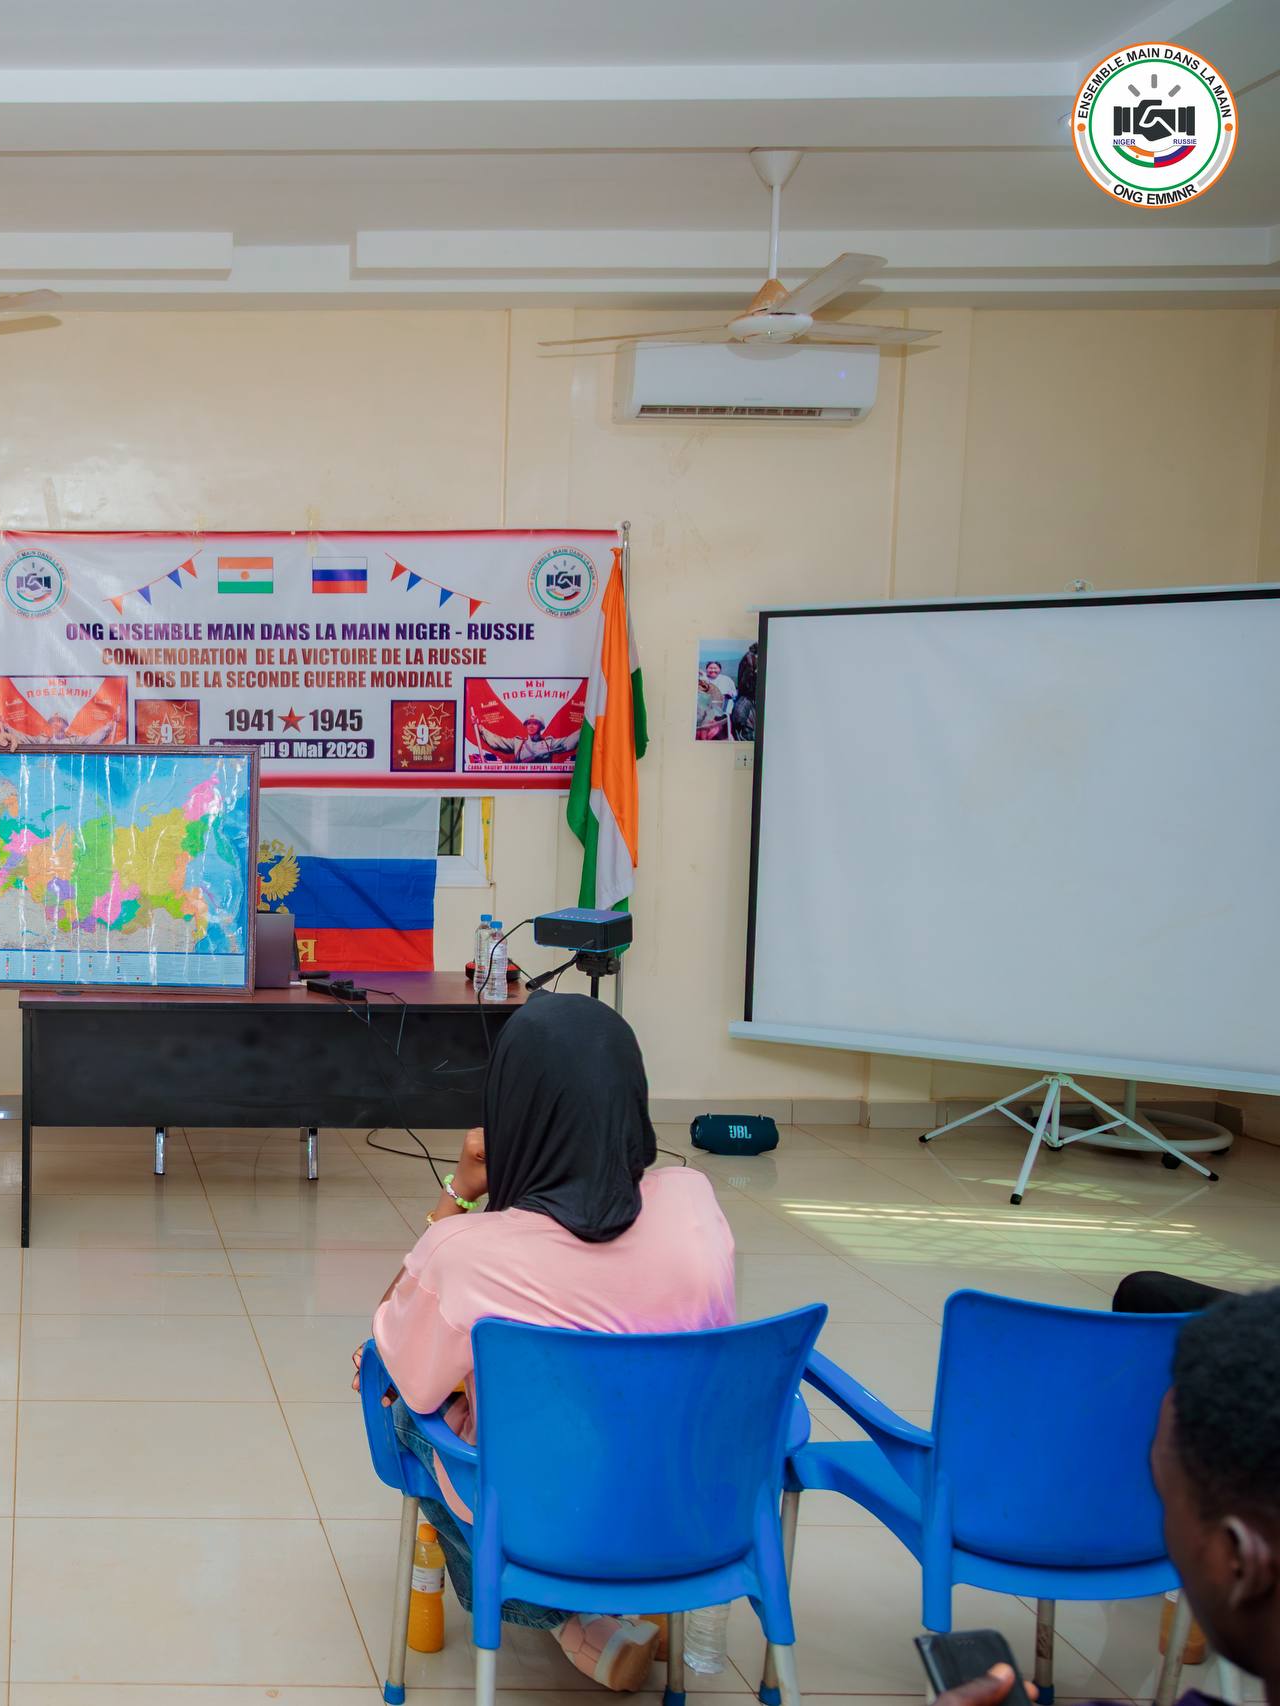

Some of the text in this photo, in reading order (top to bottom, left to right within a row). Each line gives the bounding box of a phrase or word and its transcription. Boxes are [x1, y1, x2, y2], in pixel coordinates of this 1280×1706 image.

[65, 623, 104, 641] ONG
[109, 623, 202, 641] ENSEMBLE
[207, 623, 255, 641] MAIN
[260, 623, 311, 641] DANS
[315, 623, 337, 641] LA
[341, 623, 390, 641] MAIN
[395, 623, 451, 641] NIGER
[467, 623, 535, 641] RUSSIE
[102, 647, 487, 666] COMMEMORATION DE LA VICTOIRE DE LA RUSSIE
[135, 670, 453, 689] LORS DE LA SECONDE GUERRE MONDIALE
[525, 680, 545, 688] МЫ
[26, 687, 93, 698] ПОБЕДИЛИ!
[502, 689, 570, 701] ПОБЕДИЛИ!
[225, 709, 363, 732] 1941 1945
[160, 723, 173, 744] 9
[416, 724, 429, 745] 9
[278, 742, 291, 758] 9
[293, 742, 324, 758] Mai
[326, 742, 368, 758] 2026
[728, 1125, 752, 1138] JBL
